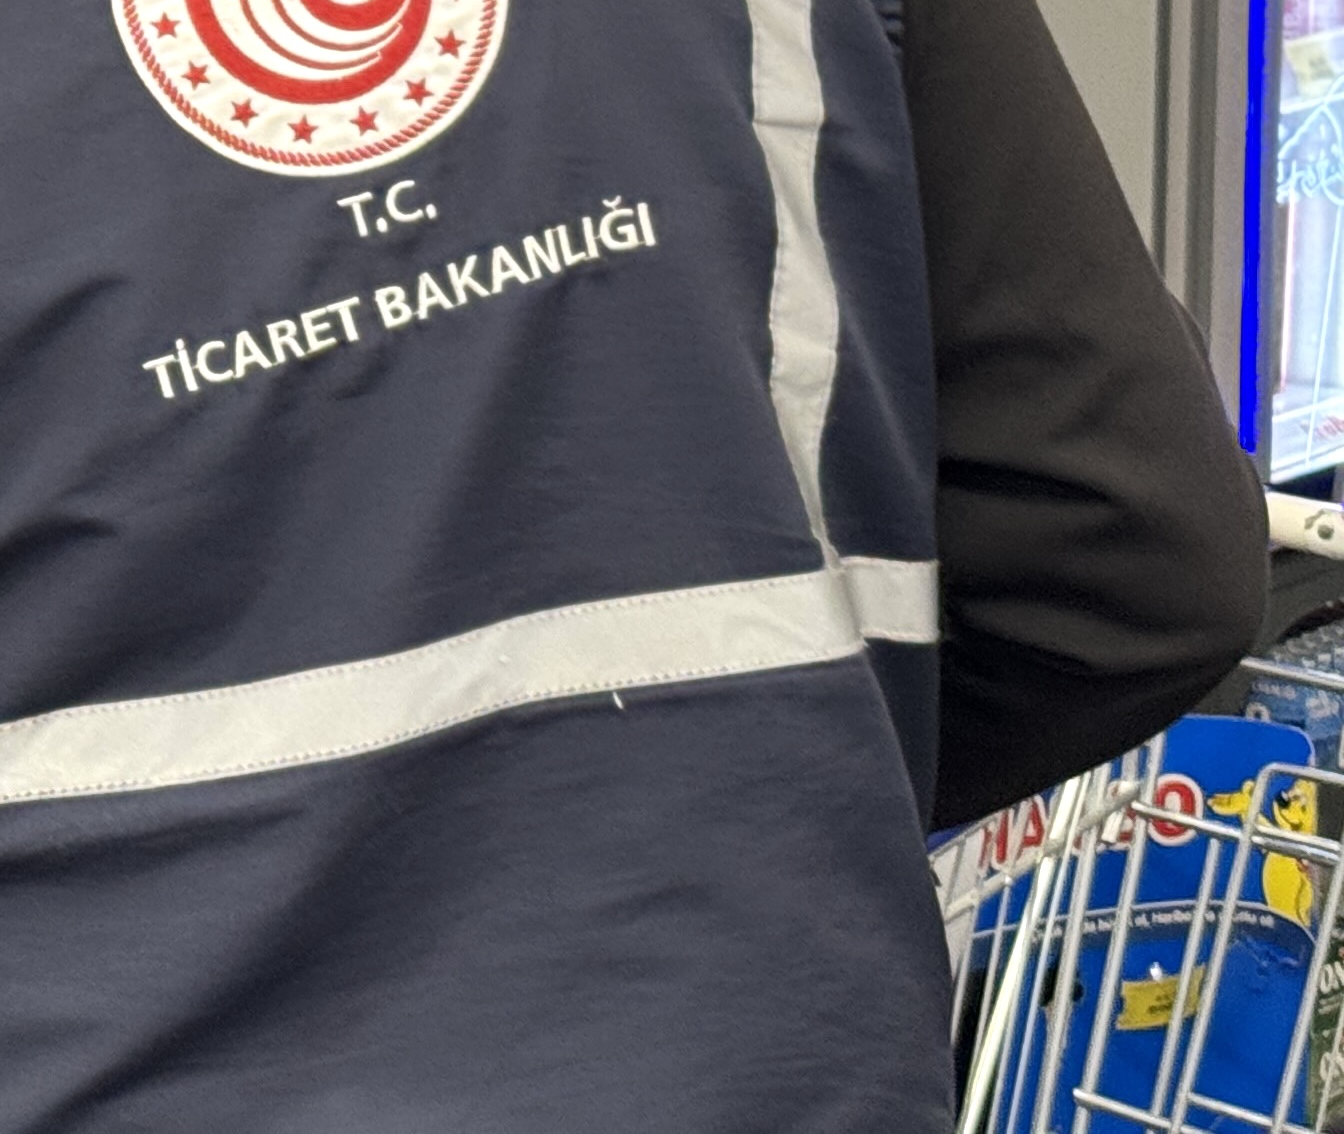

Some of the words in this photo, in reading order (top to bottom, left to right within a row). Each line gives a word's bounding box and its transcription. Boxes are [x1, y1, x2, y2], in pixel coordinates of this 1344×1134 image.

[337, 180, 438, 238] T.C.
[142, 296, 362, 398] TİCARET
[375, 195, 657, 329] BAKANLIĞI
